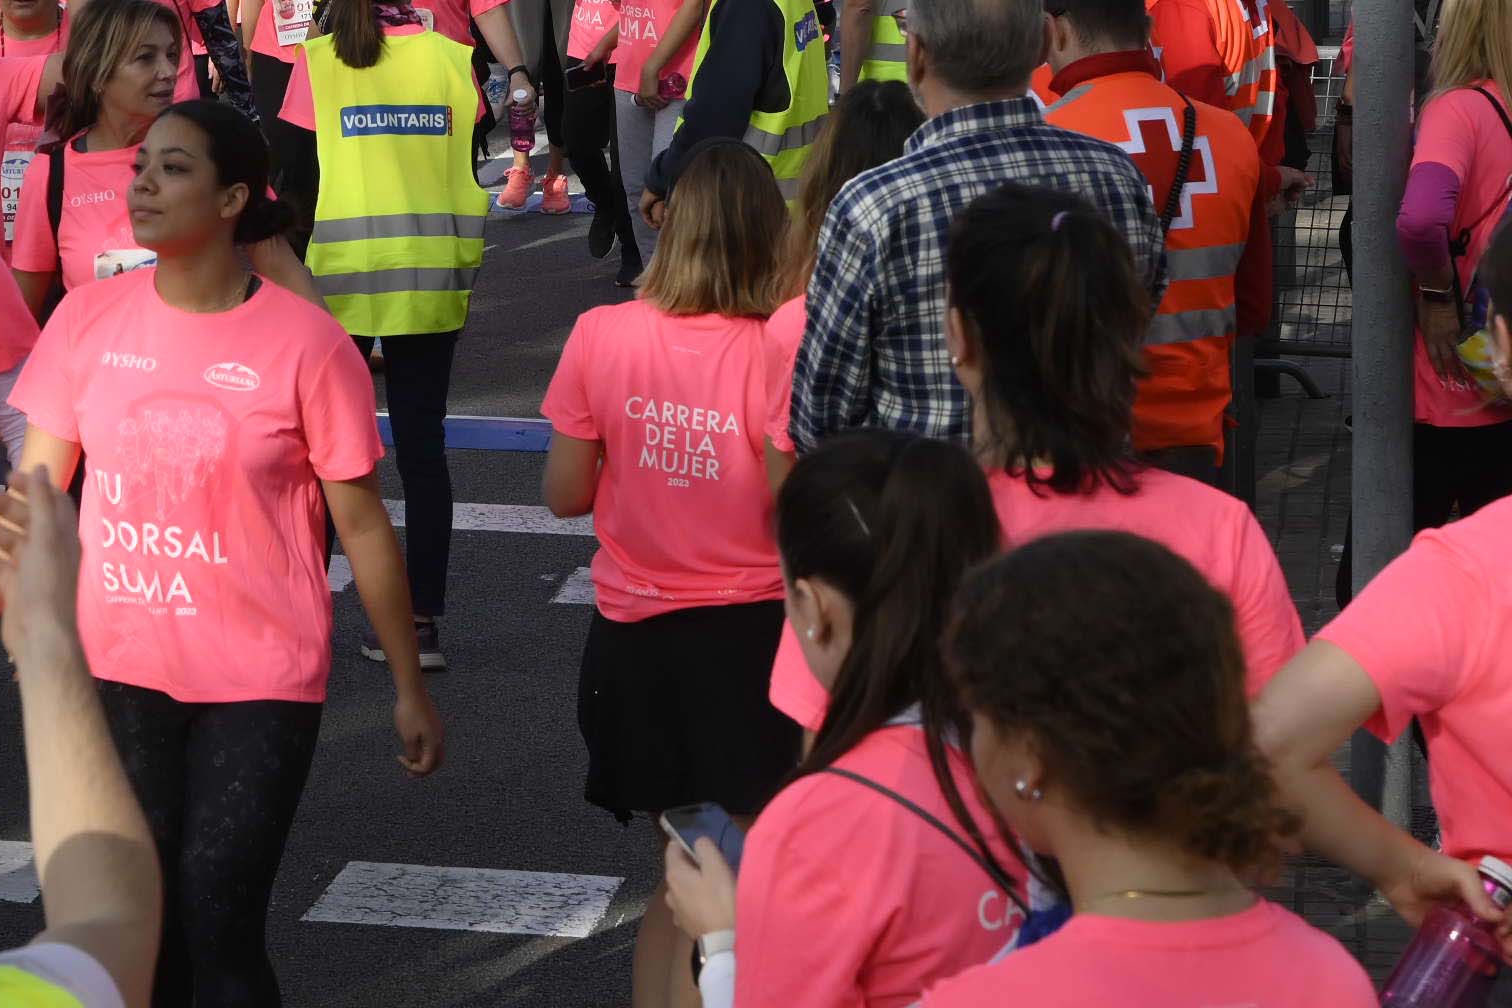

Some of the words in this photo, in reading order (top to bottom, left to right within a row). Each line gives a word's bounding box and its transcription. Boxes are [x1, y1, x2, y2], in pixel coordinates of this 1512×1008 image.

[343, 113, 445, 130] VOLUNTARIS
[70, 189, 116, 208] OYSHO
[624, 396, 740, 436] CARRERA
[645, 423, 676, 449] DE
[685, 430, 716, 457] LA
[638, 446, 720, 481] MUJER
[95, 468, 122, 506] TU
[667, 476, 690, 488] 2023
[102, 562, 194, 604] SUMA
